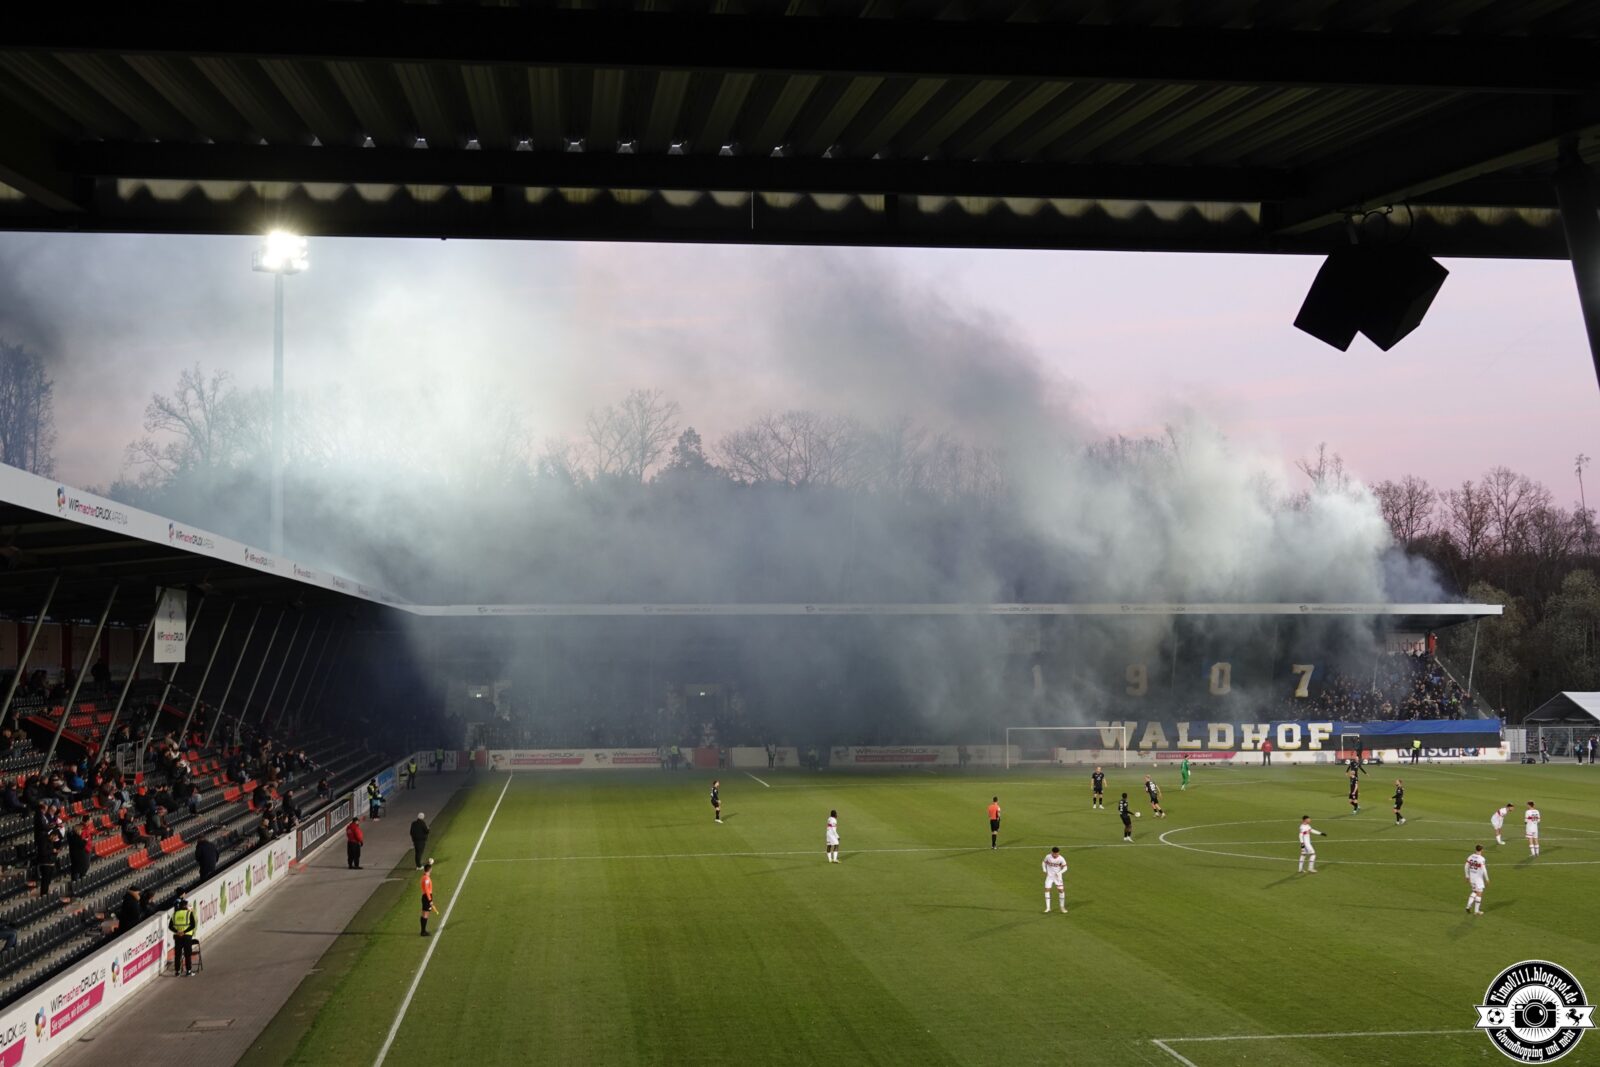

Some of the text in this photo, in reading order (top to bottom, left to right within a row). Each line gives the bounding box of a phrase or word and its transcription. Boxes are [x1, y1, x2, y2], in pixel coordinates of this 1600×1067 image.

[1125, 663, 1148, 696] 9
[1209, 662, 1232, 695] 0
[1292, 664, 1315, 697] 7
[1096, 721, 1333, 750] WALDHOF
